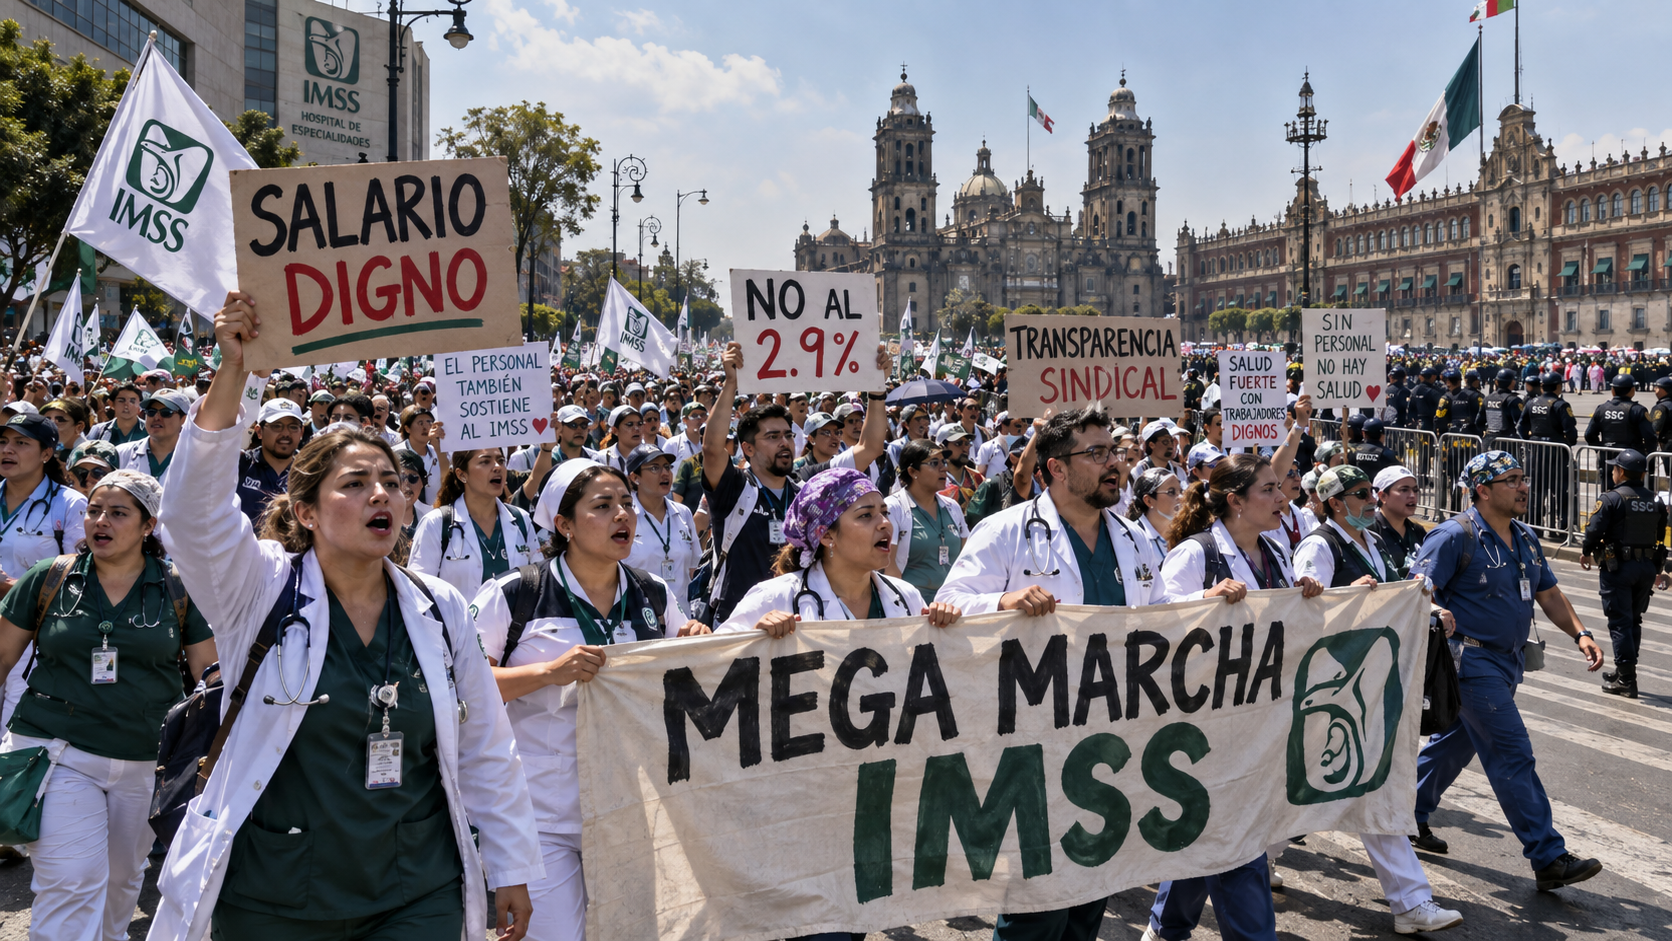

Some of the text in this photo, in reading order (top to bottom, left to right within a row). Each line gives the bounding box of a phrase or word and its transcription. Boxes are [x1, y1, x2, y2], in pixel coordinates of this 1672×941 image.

[304, 79, 361, 114] IMSS
[301, 110, 362, 133] HOSPITAL DE
[291, 123, 371, 149] ESPECIALIDADES
[108, 187, 190, 253] IMSS
[249, 173, 486, 257] SALARIO
[284, 247, 488, 336] DIGNO
[745, 277, 863, 321] NO AL
[1322, 313, 1353, 331] SIN
[756, 326, 860, 380] 2.9%
[1009, 325, 1178, 361] TRANSPARENCIA
[1314, 334, 1377, 353] PERSONAL
[444, 352, 543, 376] EL PERSONAL
[1228, 355, 1273, 372] SALUD
[1317, 358, 1368, 376] NO HAY
[455, 373, 522, 397] TAMBIÉN
[1039, 362, 1178, 405] SINDICAL
[1229, 375, 1277, 390] FUERTE
[1316, 380, 1362, 400] SALUD
[459, 396, 531, 419] SOSTIENE
[1240, 392, 1263, 405] CON
[1223, 406, 1286, 421] TRABAJADORES
[1604, 410, 1625, 420] SSC
[460, 418, 529, 441] AL IMSS
[1231, 424, 1278, 441] DIGNOS
[1631, 500, 1655, 513] SSC
[663, 620, 1285, 786] MEGA MARCHA
[853, 721, 1212, 904] IMSS
